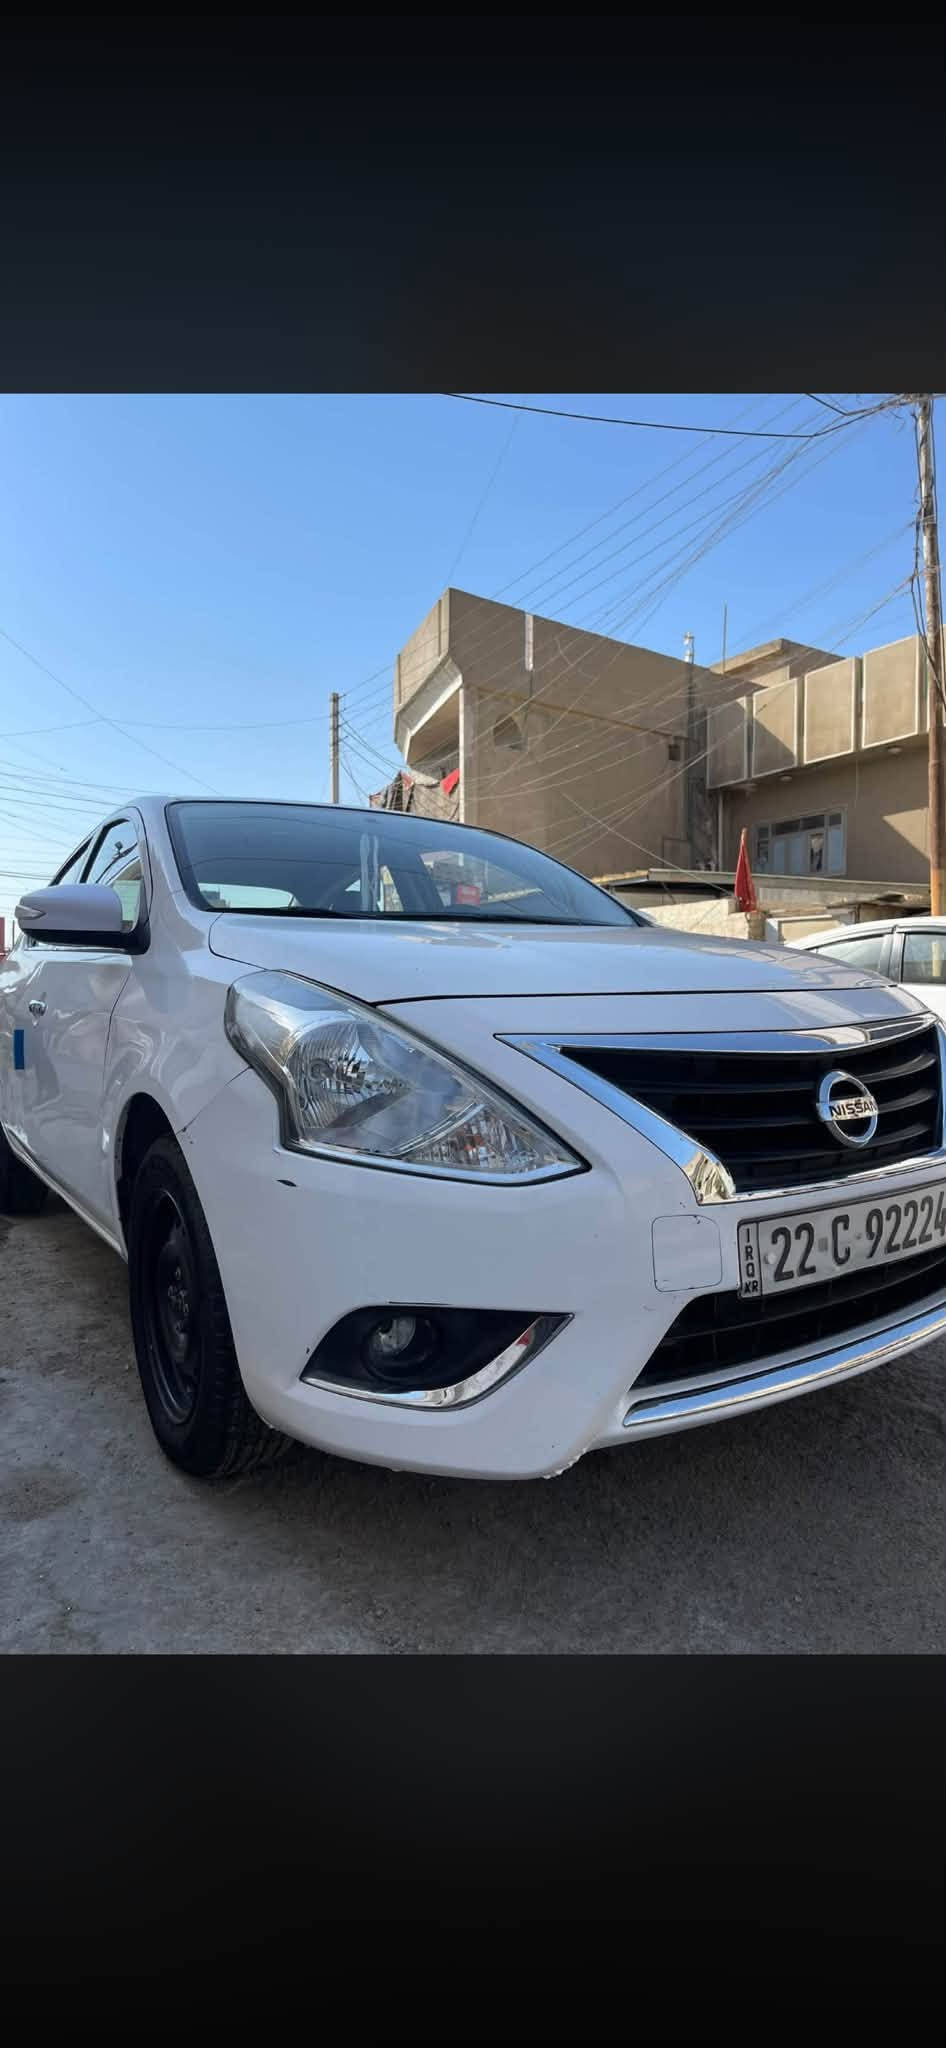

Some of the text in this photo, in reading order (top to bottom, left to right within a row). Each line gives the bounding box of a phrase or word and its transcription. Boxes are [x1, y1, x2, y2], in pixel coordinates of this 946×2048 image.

[828, 1101, 876, 1117] NISSAN
[745, 1228, 755, 1278] IRQ
[771, 1191, 946, 1282] 22 C 92224
